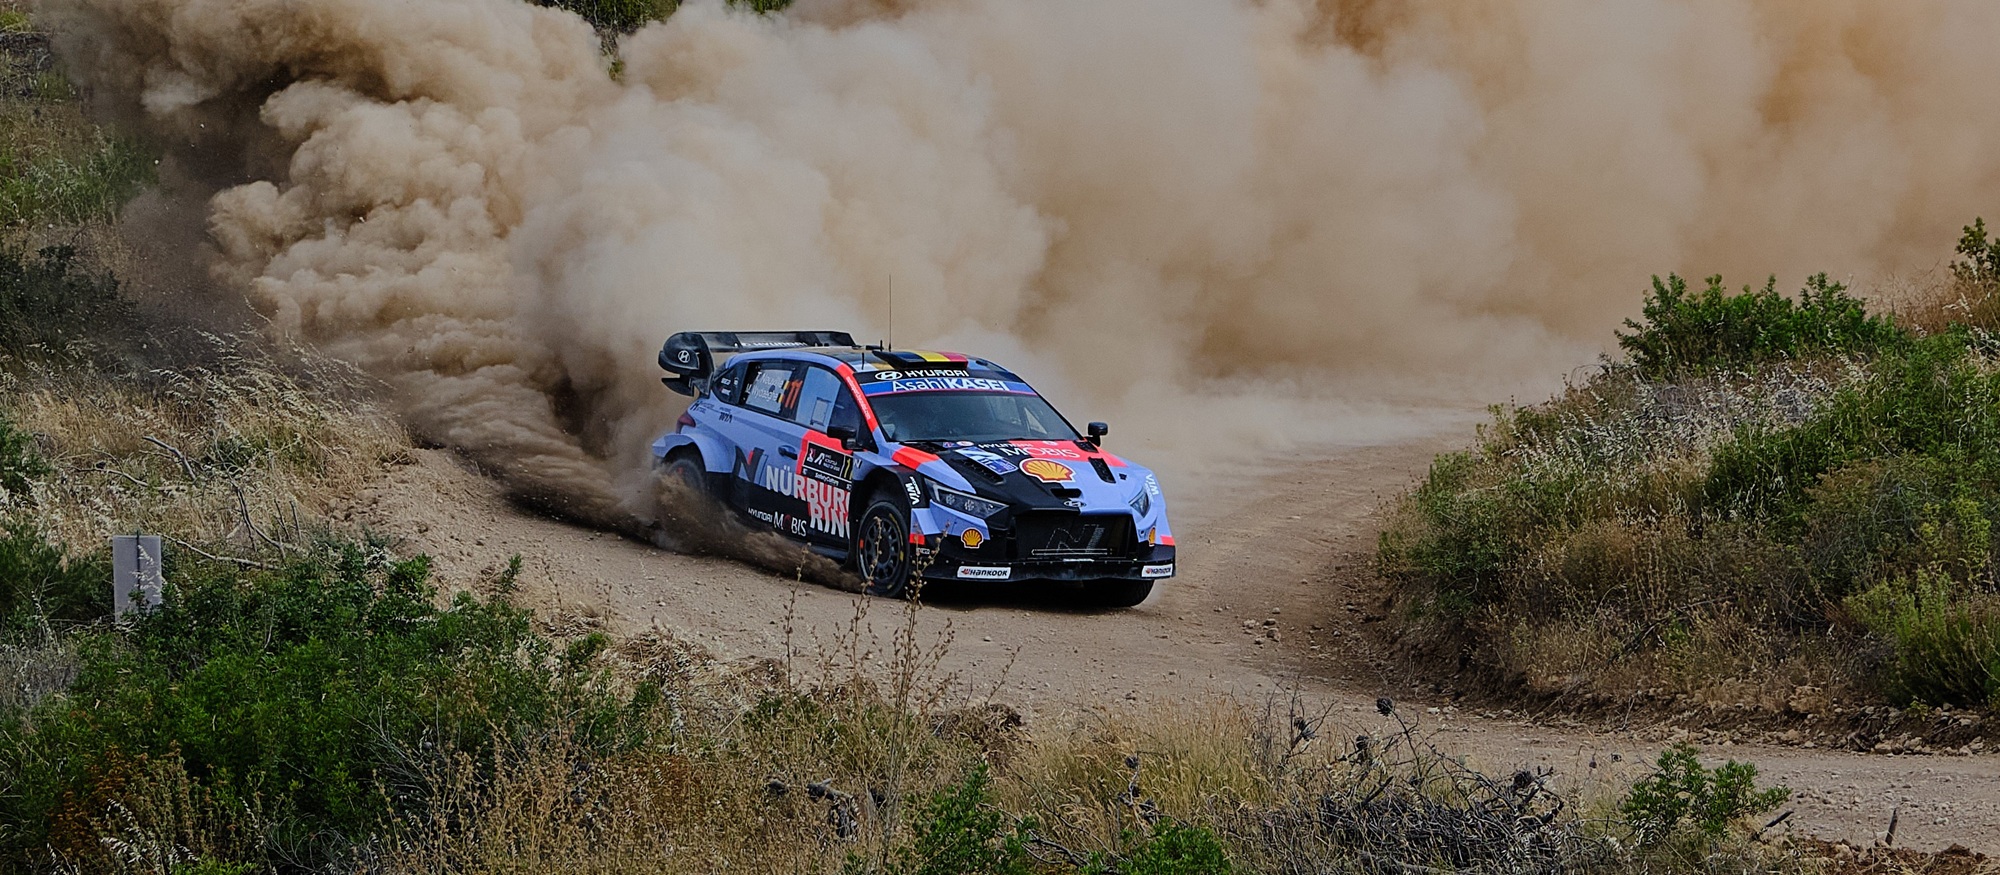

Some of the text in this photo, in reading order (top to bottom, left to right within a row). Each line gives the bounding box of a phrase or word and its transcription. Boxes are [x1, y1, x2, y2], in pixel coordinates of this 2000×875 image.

[906, 370, 970, 378] HYUNDAI
[893, 377, 1010, 392] AsahiKASEI
[785, 379, 803, 409] 11
[1000, 447, 1080, 458] MOBIS
[747, 507, 807, 537] HYUNDAI MOBIS
